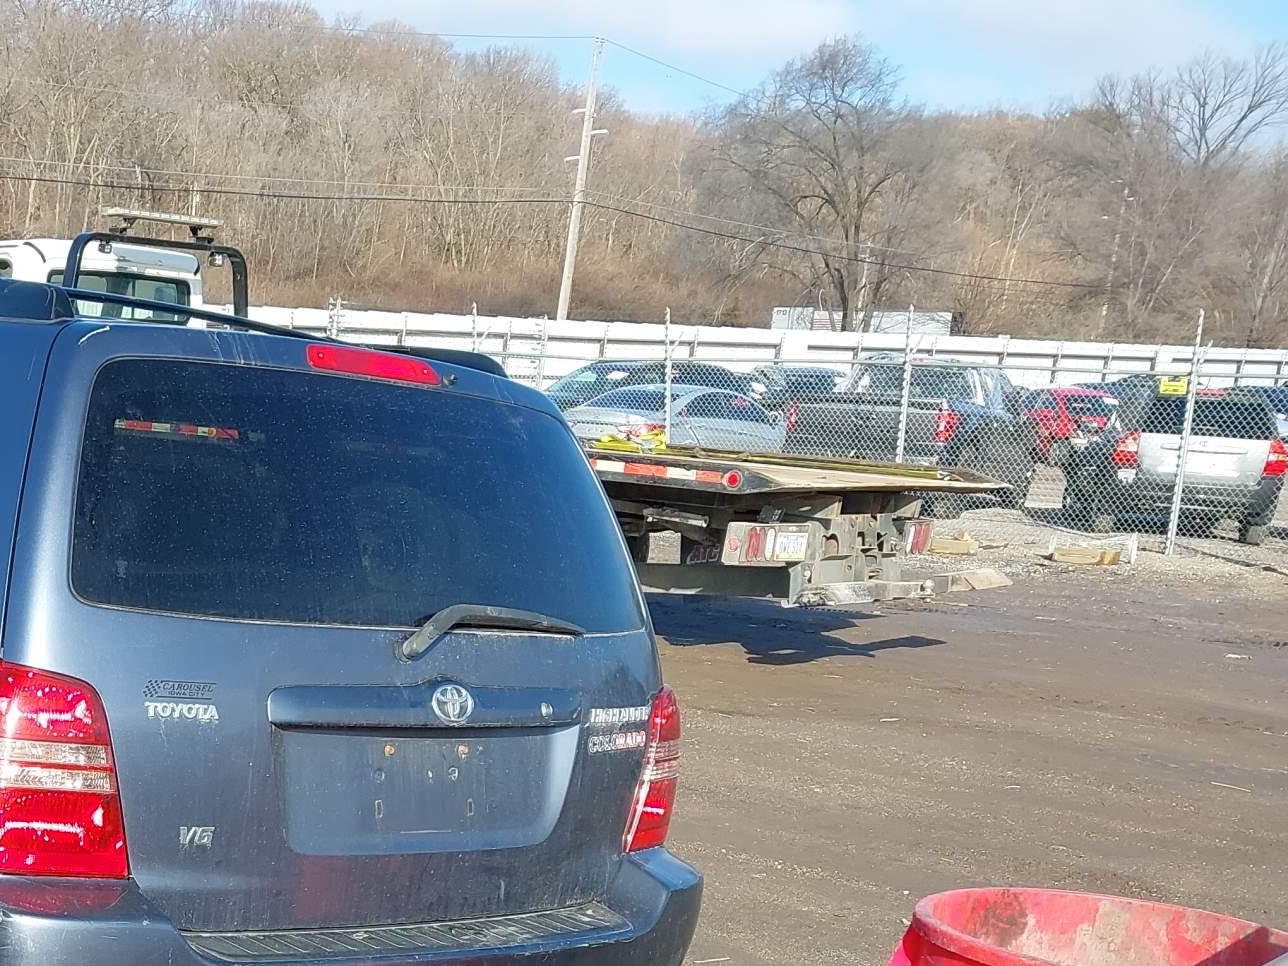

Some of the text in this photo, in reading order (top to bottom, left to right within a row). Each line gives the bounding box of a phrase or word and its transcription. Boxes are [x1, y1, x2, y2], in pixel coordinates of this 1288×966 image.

[162, 683, 214, 693] CAROUSEL
[144, 702, 219, 720] TOYOTA
[179, 826, 215, 846] V6
